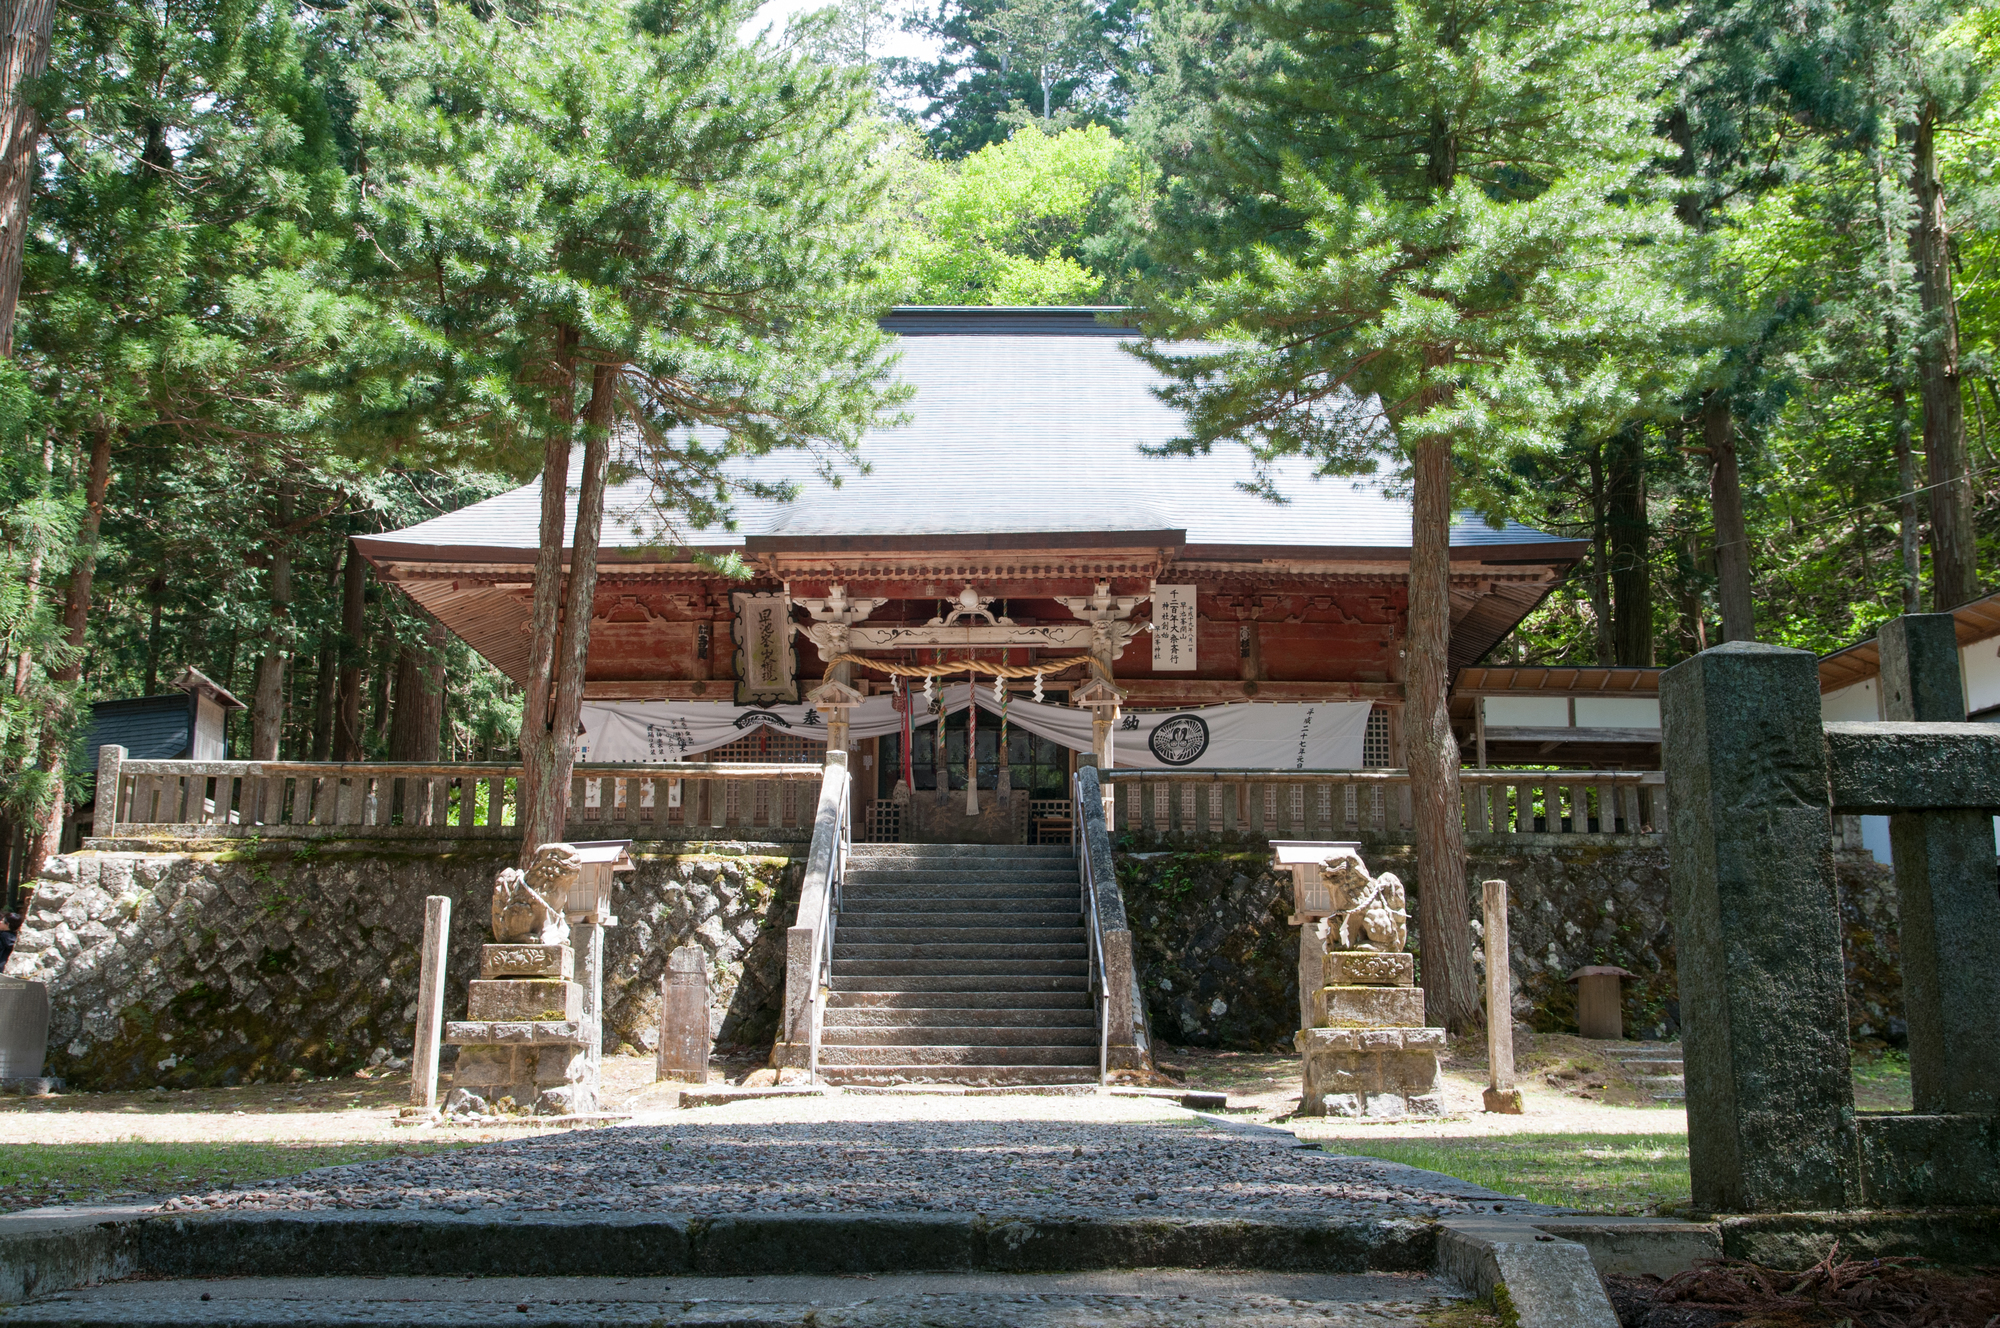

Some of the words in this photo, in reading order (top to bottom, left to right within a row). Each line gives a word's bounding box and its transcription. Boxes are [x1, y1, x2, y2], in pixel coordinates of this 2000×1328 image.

[803, 708, 821, 726] 奉
[1121, 714, 1140, 731] 納
[1296, 707, 1315, 769] 平成二十七年元日
